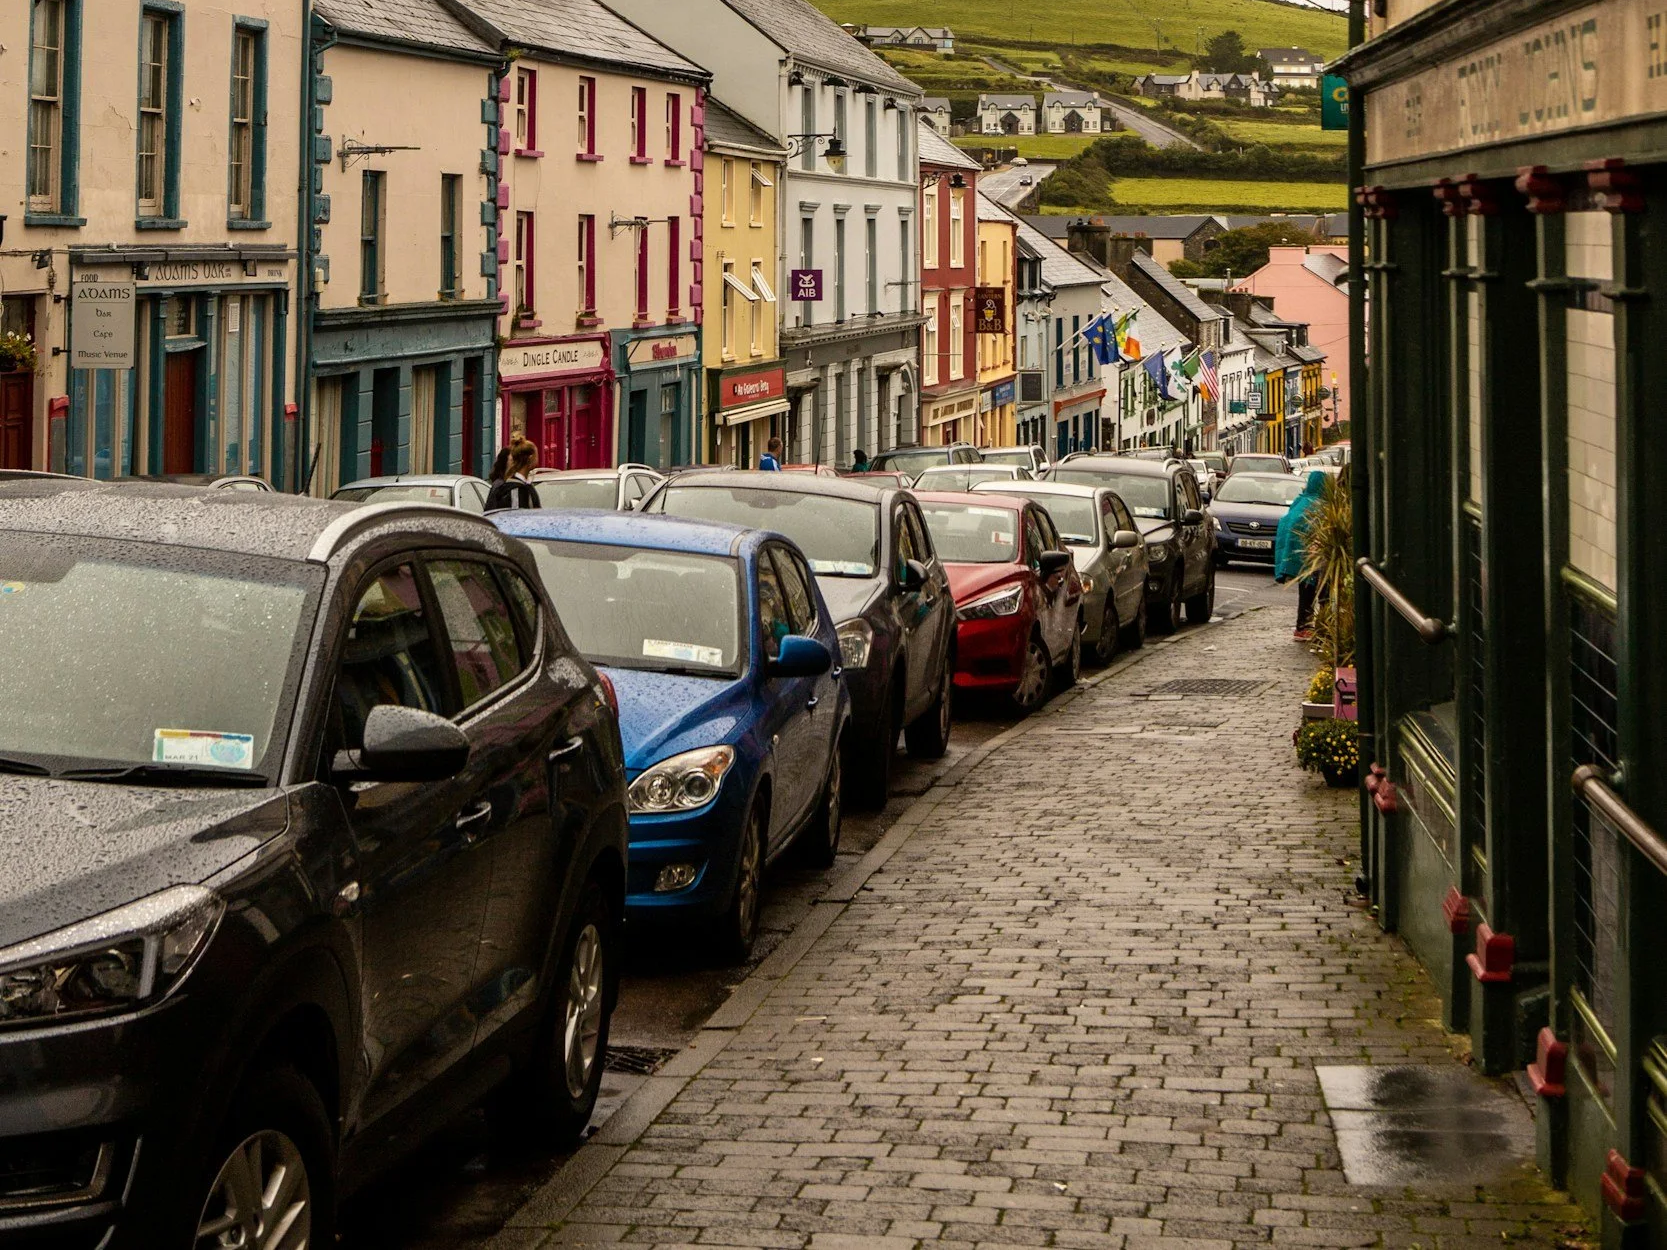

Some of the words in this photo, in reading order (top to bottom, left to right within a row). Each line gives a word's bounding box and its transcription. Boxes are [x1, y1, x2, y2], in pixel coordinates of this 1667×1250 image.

[81, 273, 99, 282] FOOD
[797, 288, 817, 298] AIB
[978, 318, 1002, 331] B&B
[78, 351, 102, 359] Music
[103, 351, 128, 359] Venue
[523, 352, 550, 367] DINGLE
[552, 349, 579, 364] CANDLE
